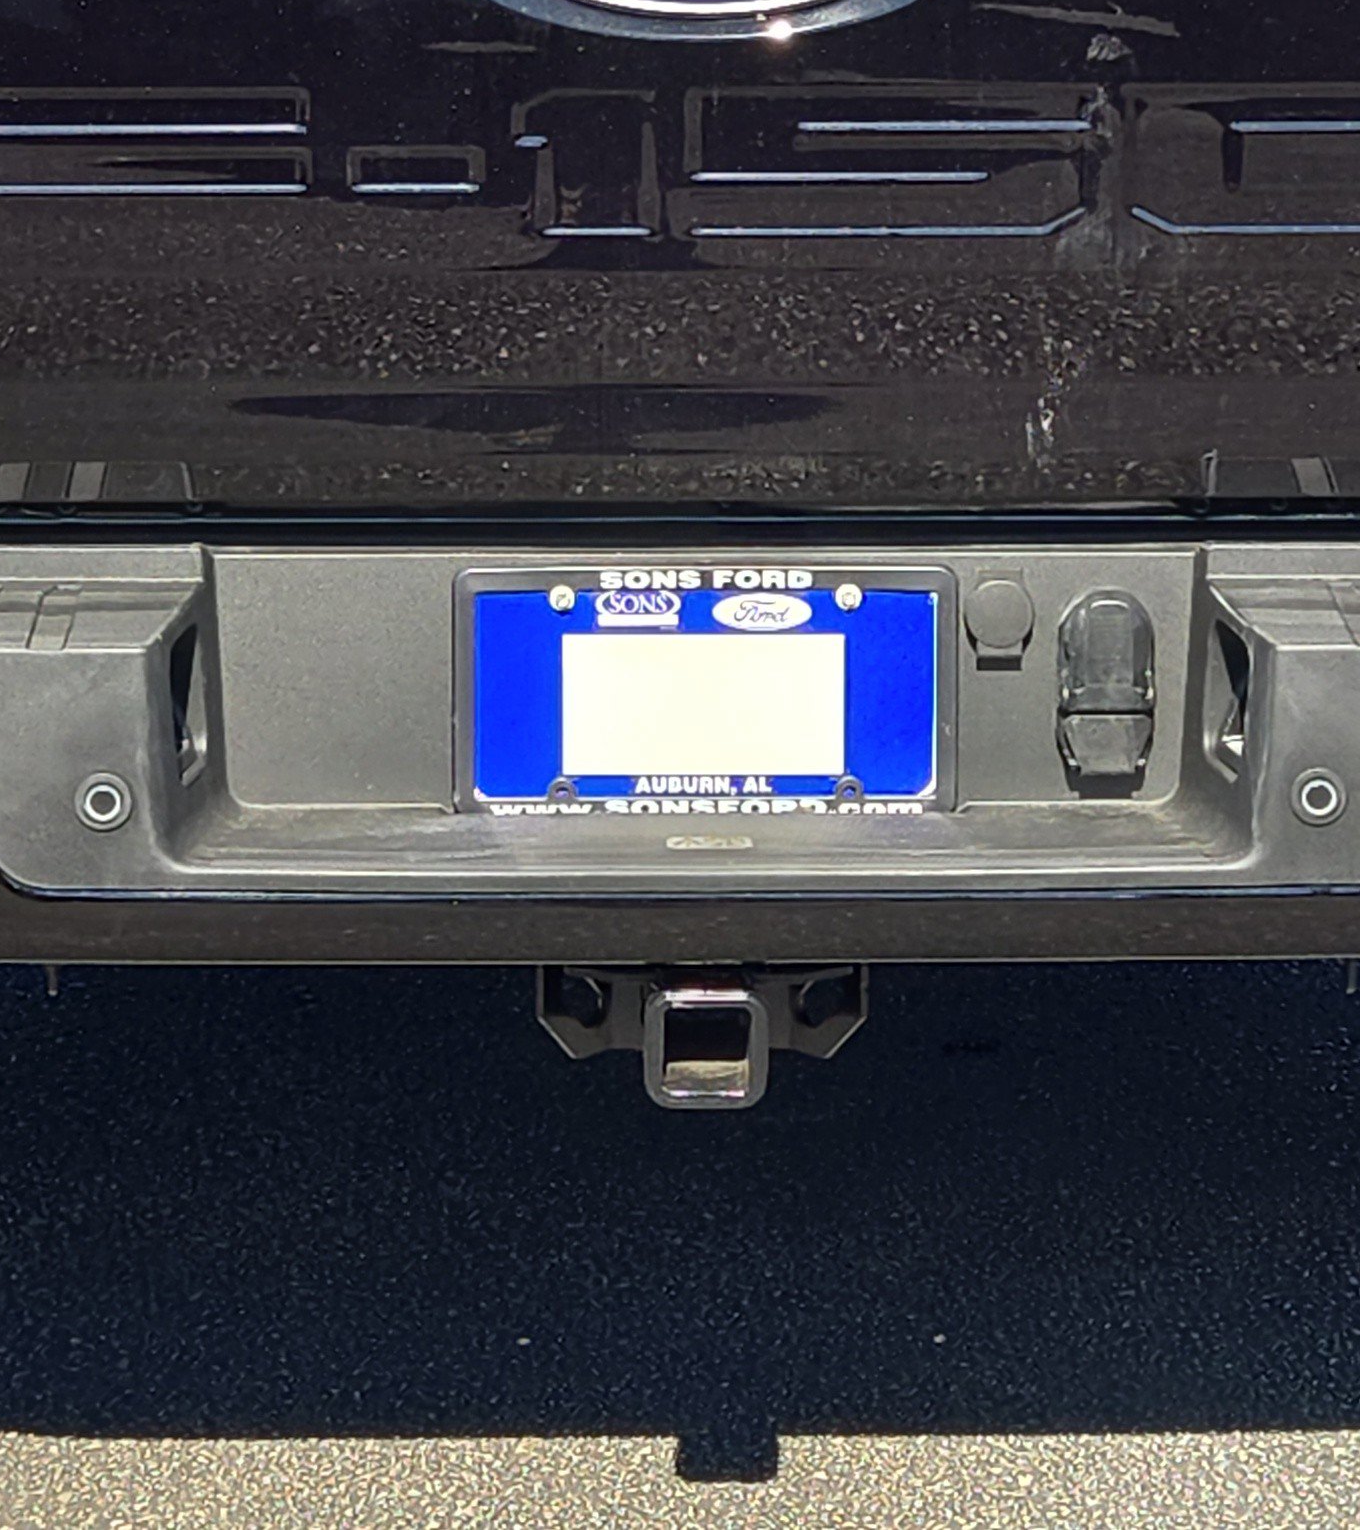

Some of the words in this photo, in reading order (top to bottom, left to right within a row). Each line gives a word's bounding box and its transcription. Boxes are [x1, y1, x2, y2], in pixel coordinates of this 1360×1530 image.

[599, 570, 701, 590] SONS
[712, 570, 813, 589] FORD
[607, 592, 669, 615] SONS
[733, 600, 791, 624] Ford
[635, 776, 738, 796] AUBURN,
[742, 776, 773, 794] AL
